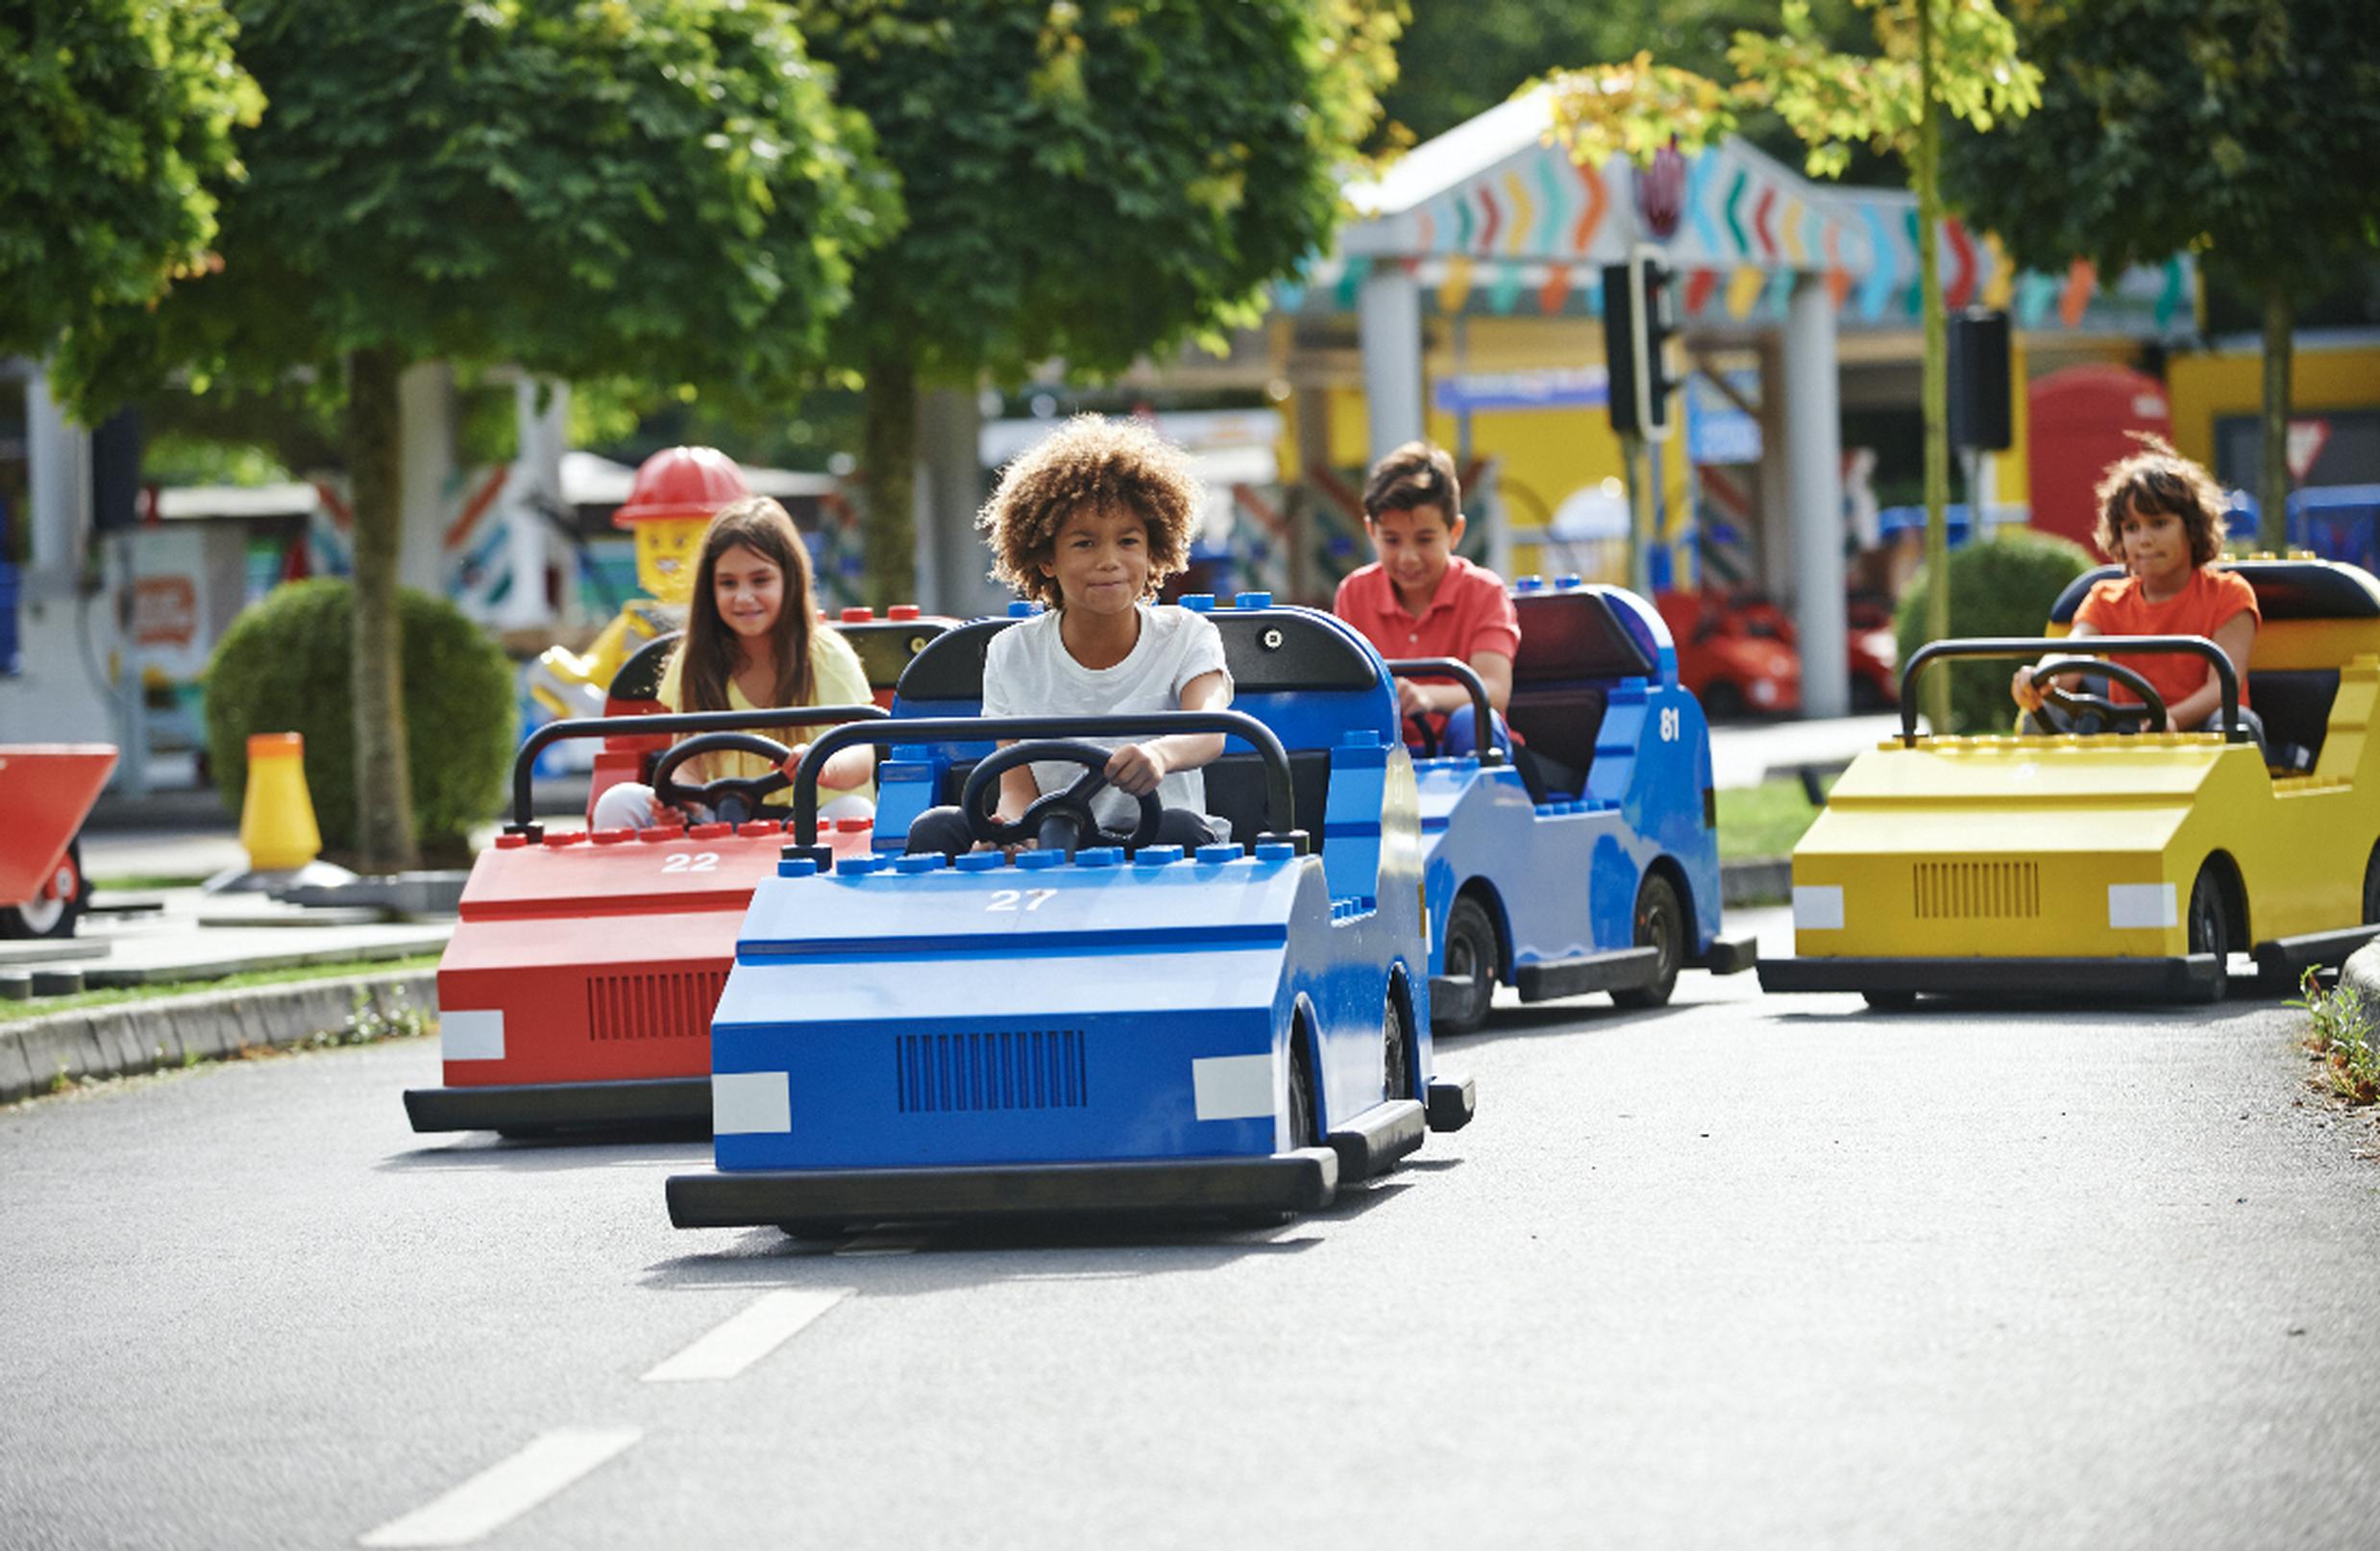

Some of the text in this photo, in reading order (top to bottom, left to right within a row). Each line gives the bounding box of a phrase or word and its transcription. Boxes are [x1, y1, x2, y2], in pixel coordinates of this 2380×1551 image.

[1659, 707, 1680, 742] 81
[661, 852, 720, 874] 22
[985, 889, 1059, 911] 27
